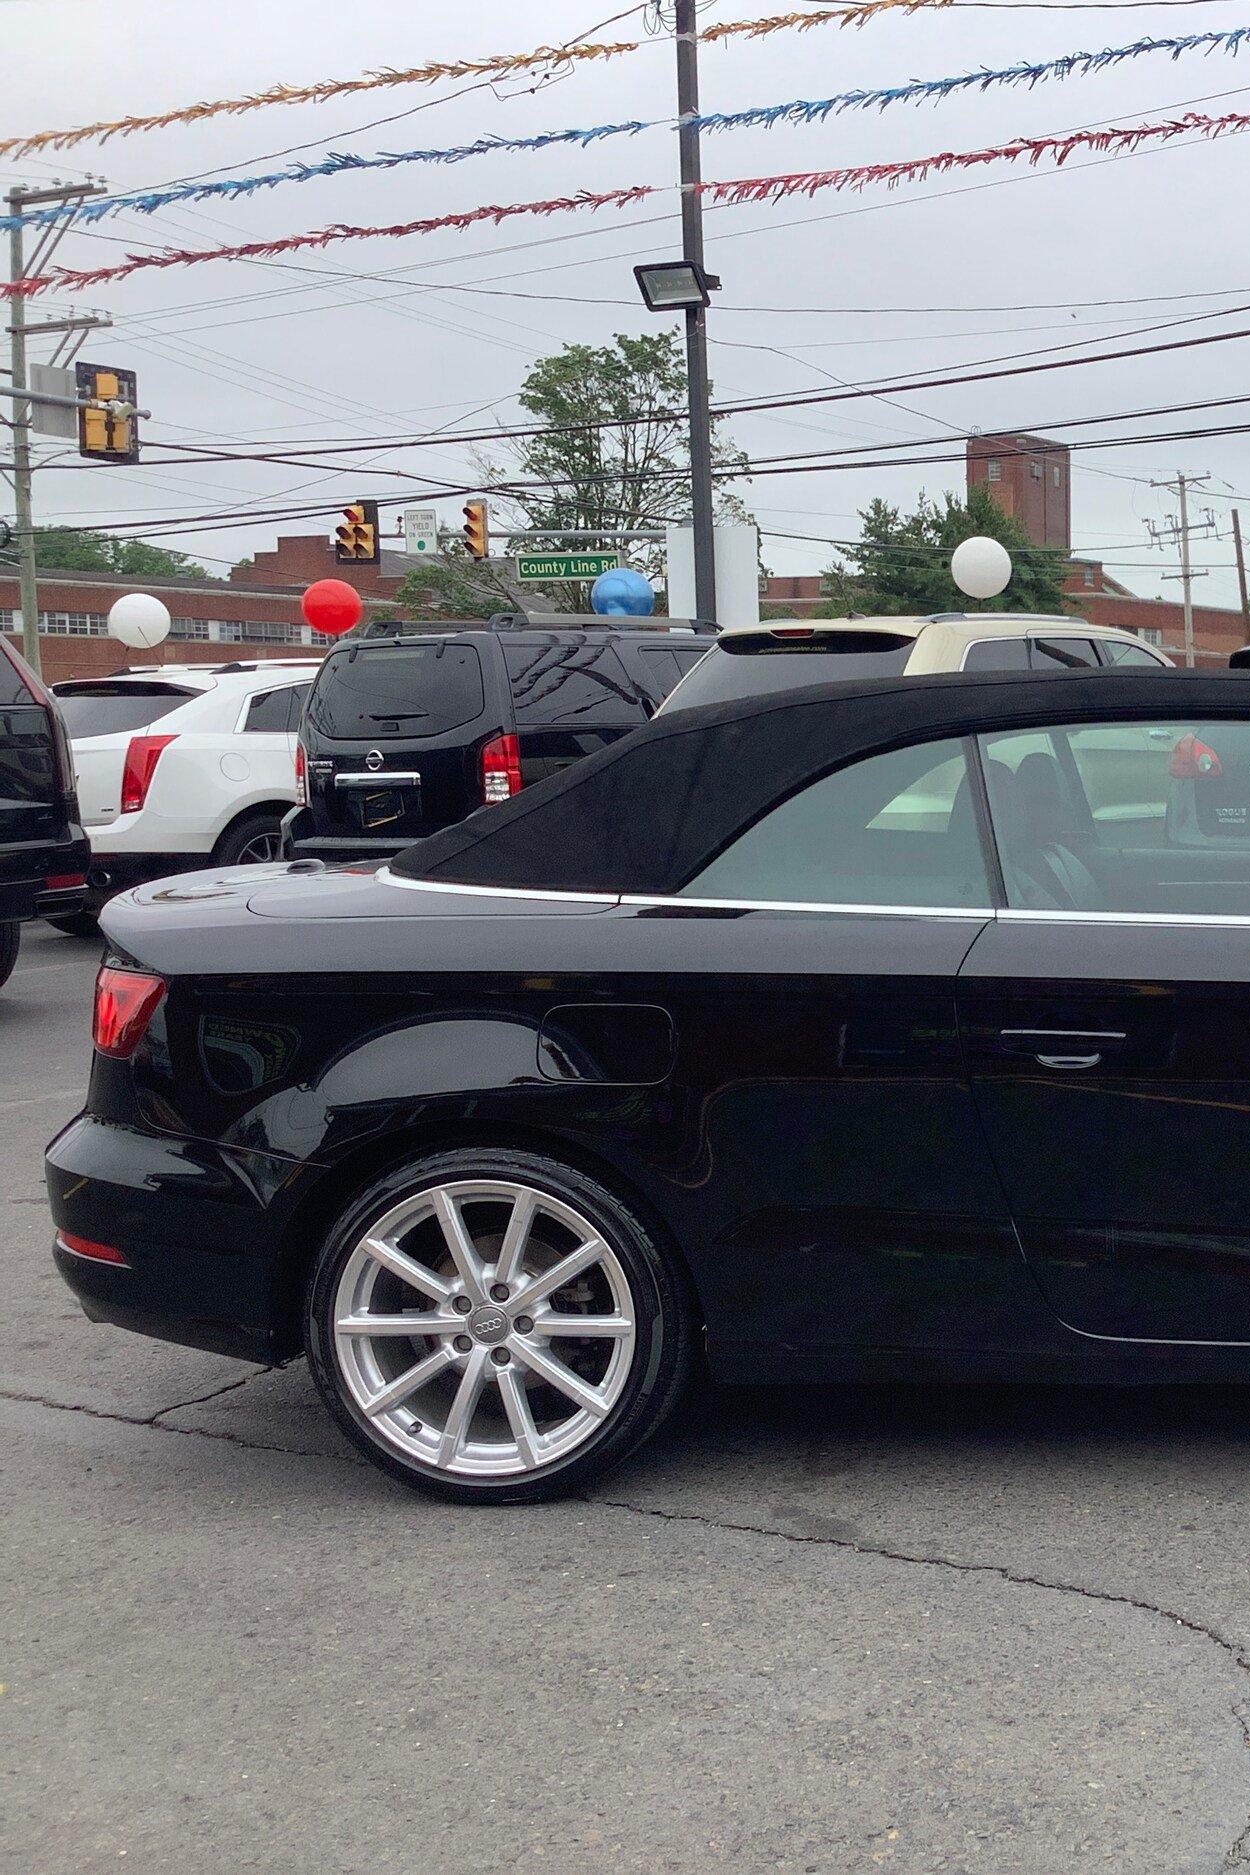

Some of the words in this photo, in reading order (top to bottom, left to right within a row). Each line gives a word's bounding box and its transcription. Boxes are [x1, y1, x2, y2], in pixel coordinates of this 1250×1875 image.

[412, 522, 430, 530] YIELD
[520, 561, 567, 576] County
[570, 560, 597, 573] Line
[601, 559, 617, 573] Rd
